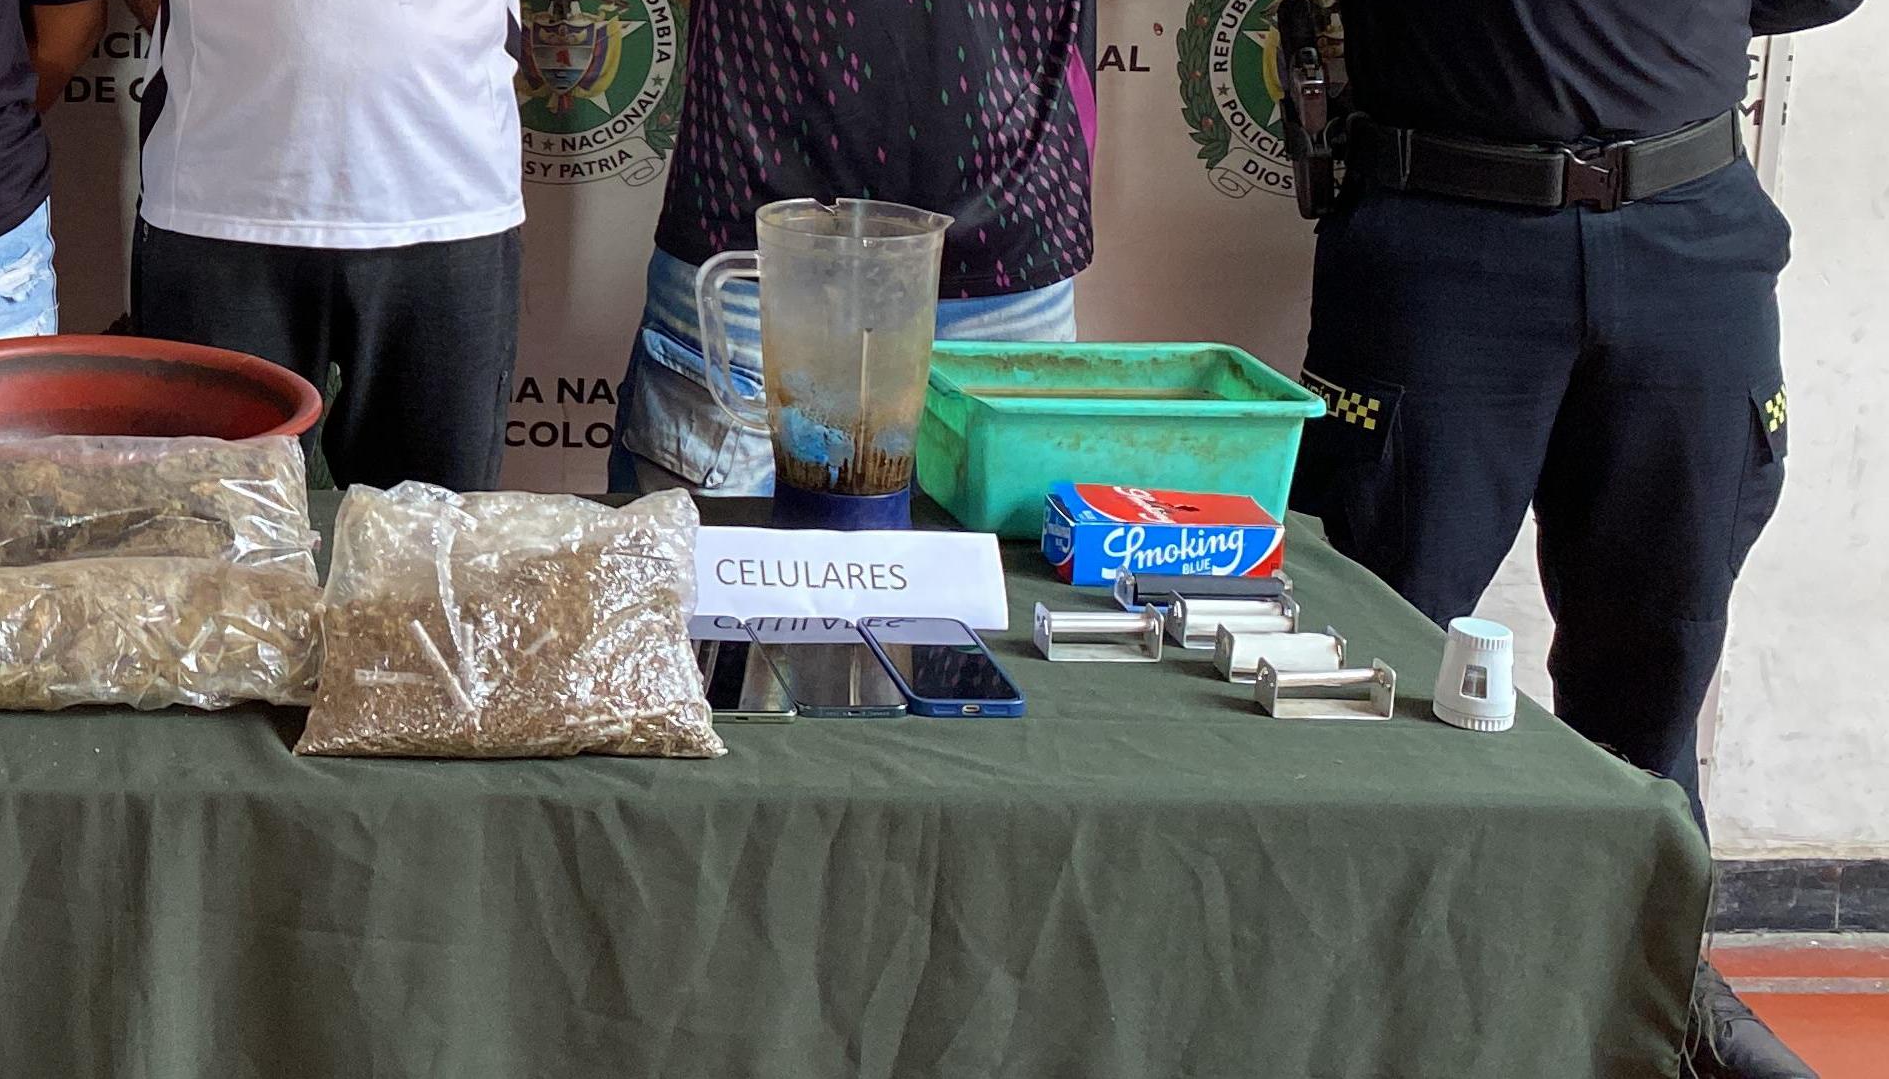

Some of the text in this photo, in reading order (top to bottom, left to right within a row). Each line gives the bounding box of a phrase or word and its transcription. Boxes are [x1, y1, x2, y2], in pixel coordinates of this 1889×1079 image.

[64, 76, 115, 104] DE
[560, 88, 661, 153] NACIONAL
[559, 148, 633, 179] PATRIA
[1242, 158, 1293, 190] DIOS
[505, 420, 614, 448] COLO
[1101, 526, 1245, 579] Smoking
[1181, 558, 1212, 575] BLUE
[715, 558, 908, 591] CELULARES
